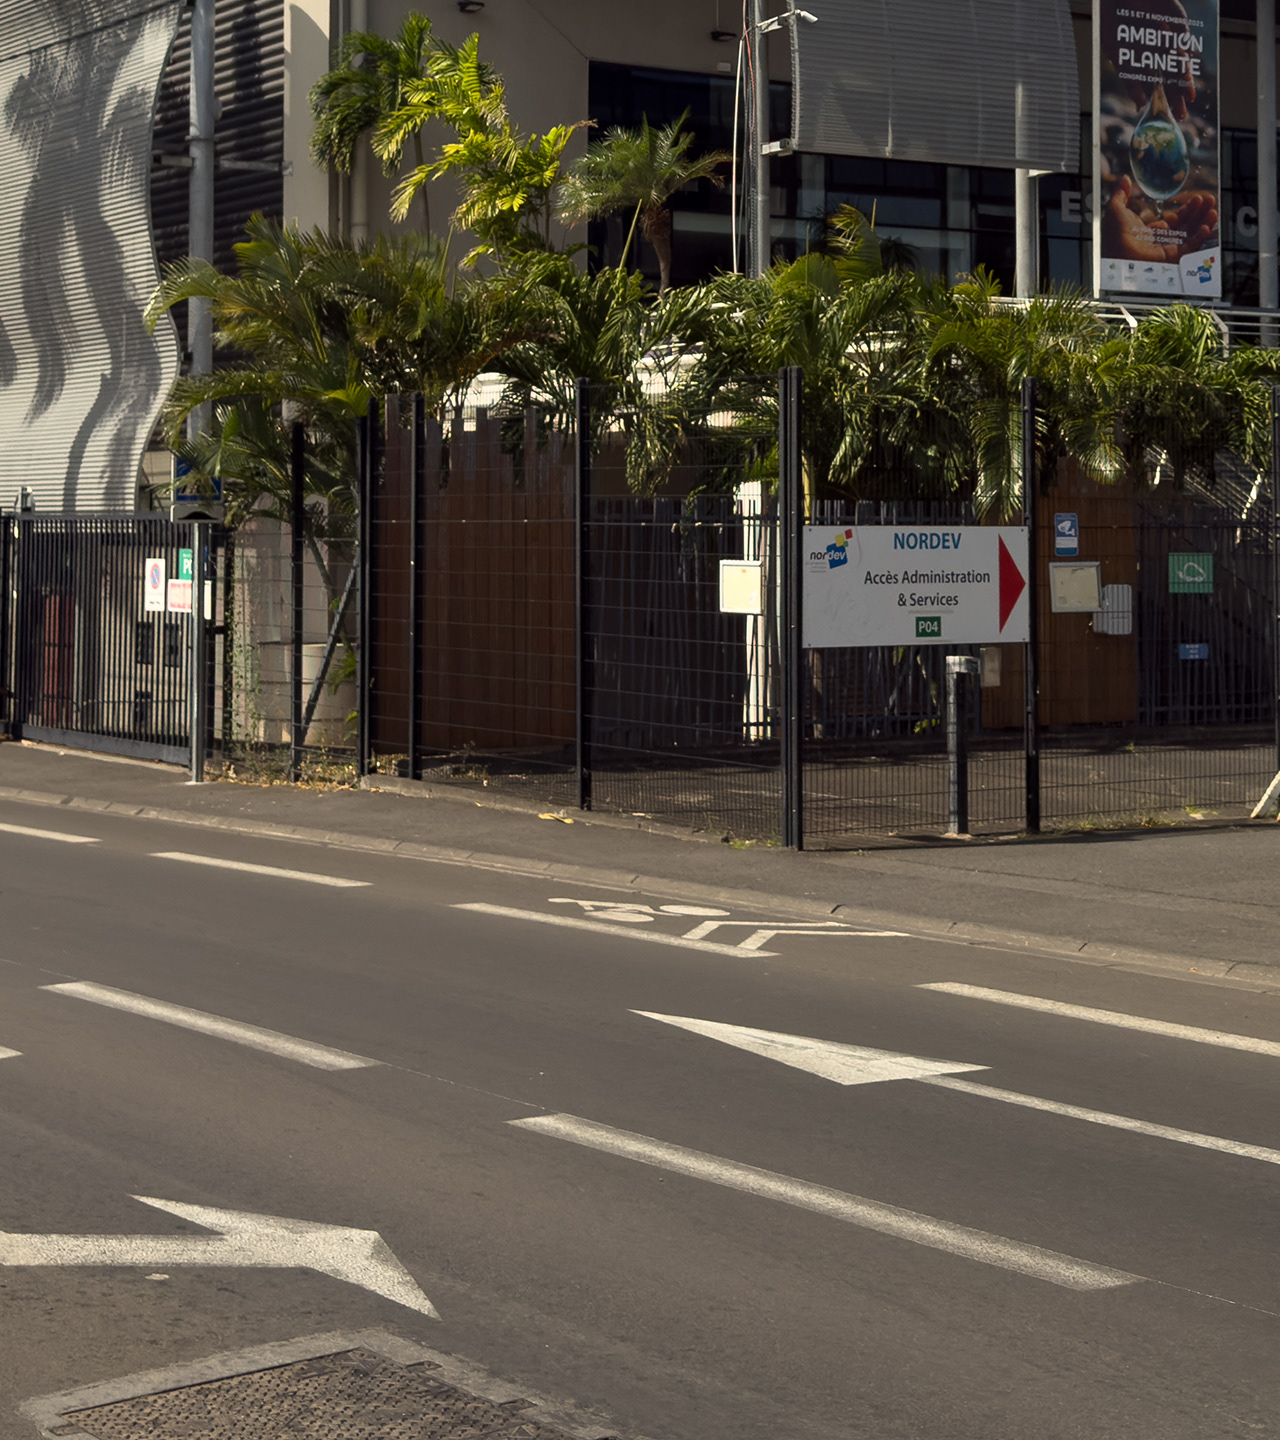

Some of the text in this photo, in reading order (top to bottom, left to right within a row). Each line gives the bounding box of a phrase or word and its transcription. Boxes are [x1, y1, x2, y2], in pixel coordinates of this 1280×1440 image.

[1136, 11, 1145, 19] ET
[1151, 13, 1188, 25] NOVEMBRE
[1116, 24, 1204, 53] AMBITION
[893, 532, 962, 550] NORDEV
[810, 550, 846, 560] nordev
[864, 569, 991, 585] Accès Administration
[897, 592, 959, 607] & Services
[918, 620, 939, 634] P04
